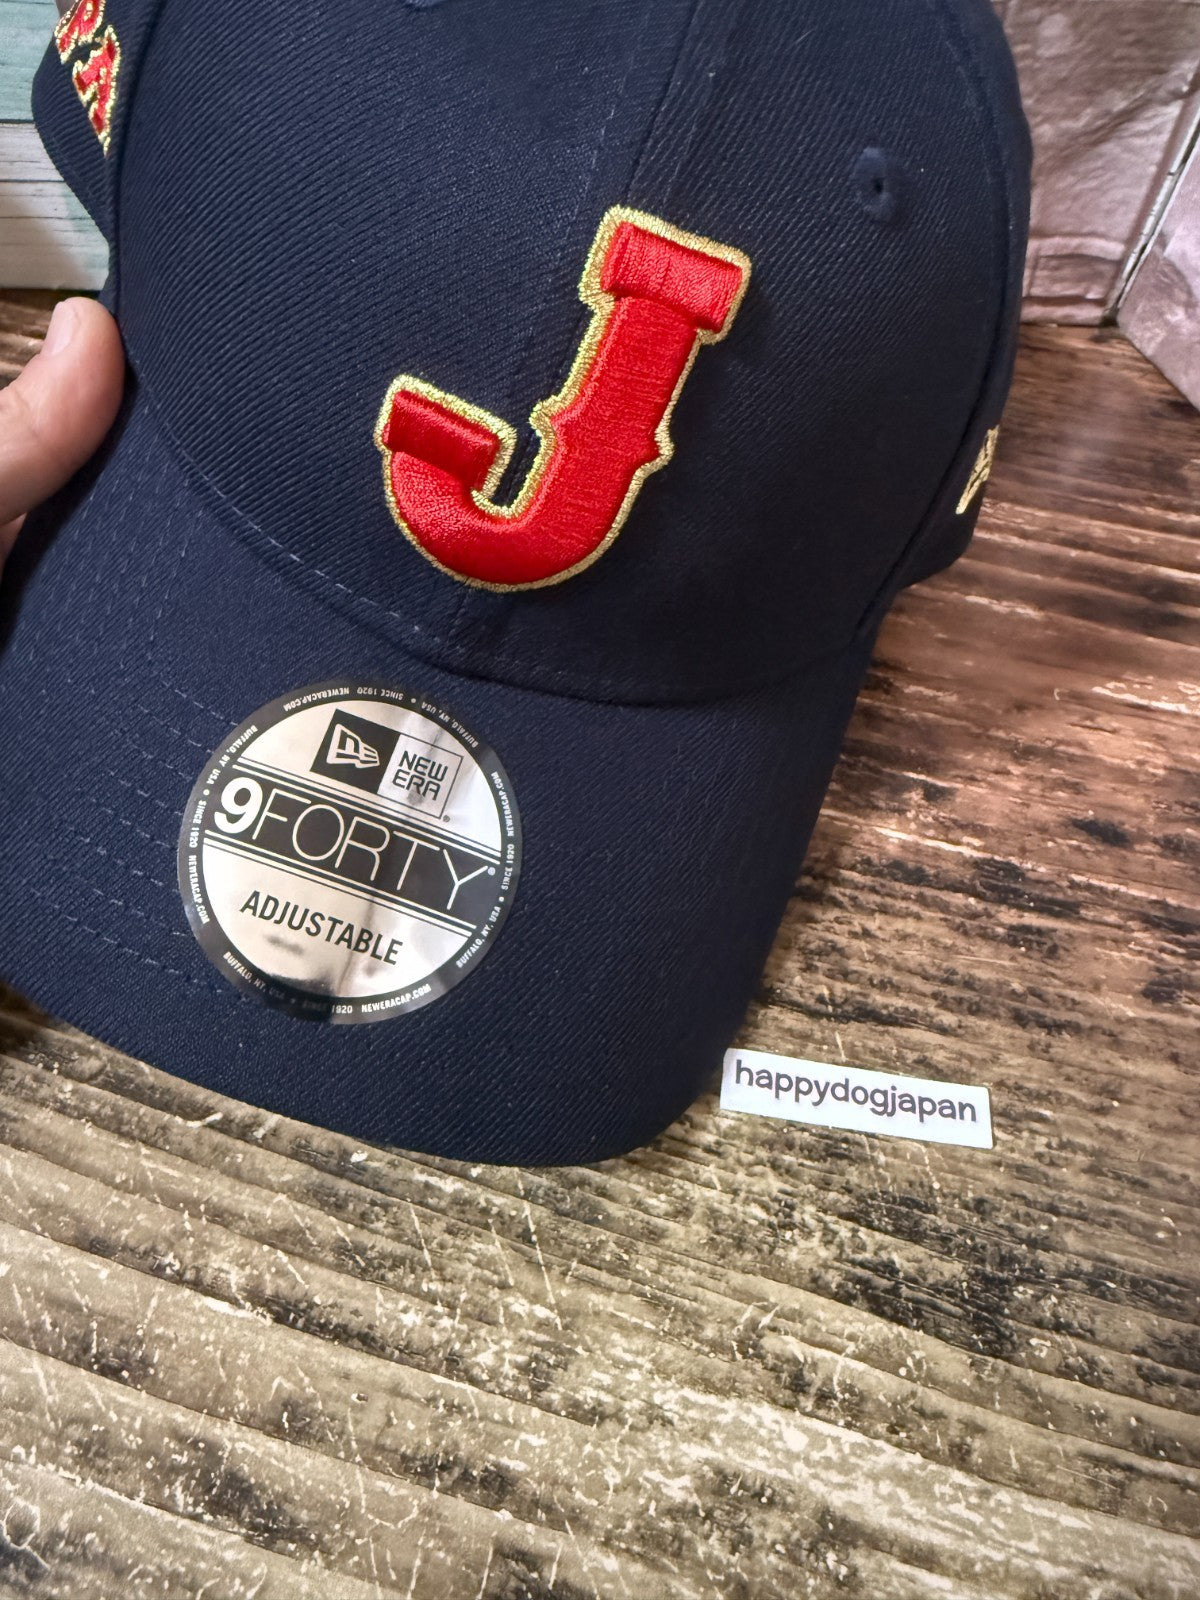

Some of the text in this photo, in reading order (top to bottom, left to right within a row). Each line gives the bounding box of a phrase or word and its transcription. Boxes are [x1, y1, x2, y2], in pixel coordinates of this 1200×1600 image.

[373, 205, 753, 592] J
[283, 686, 404, 712] SINCE 1920 NEWERACAP.COM
[421, 701, 437, 714] USA
[206, 769, 221, 784] USA
[399, 750, 449, 782] NEW
[392, 769, 442, 801] ERA
[213, 777, 489, 910] 9FORTY
[490, 771, 515, 890] SINCE 1920 NEWERACAP.COM
[188, 800, 210, 924] SINCE 1920 NEWERACAP.COM
[239, 890, 403, 966] ADJUSTABLE
[489, 906, 501, 922] USA
[332, 1005, 353, 1013] 1920
[361, 983, 432, 1013] NEWERACAP.COM
[735, 1059, 977, 1123] happydogjapan
